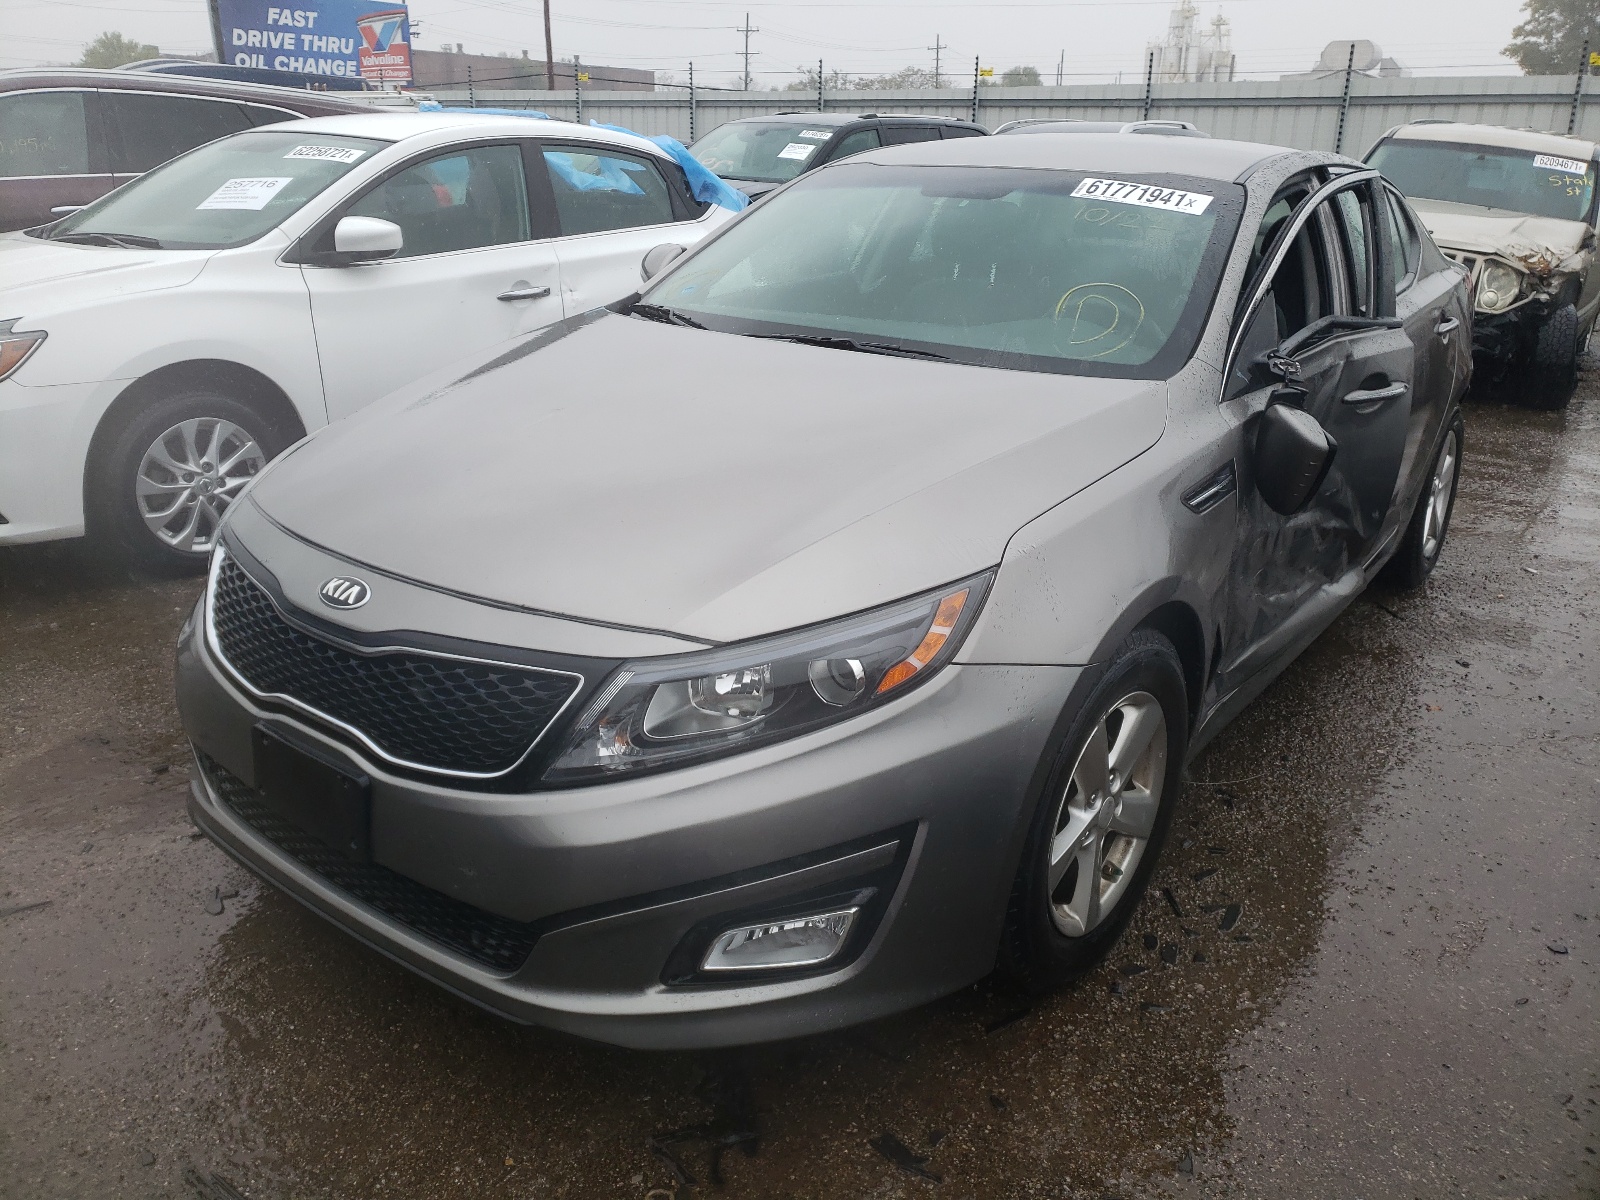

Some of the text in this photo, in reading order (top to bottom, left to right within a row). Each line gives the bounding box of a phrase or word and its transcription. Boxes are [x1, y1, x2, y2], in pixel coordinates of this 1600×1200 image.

[267, 7, 318, 28] FAST
[232, 28, 354, 55] DRIVE THRU
[234, 52, 357, 77] OIL CHANGE
[361, 54, 405, 66] Valvoline
[321, 577, 361, 605] KIA
